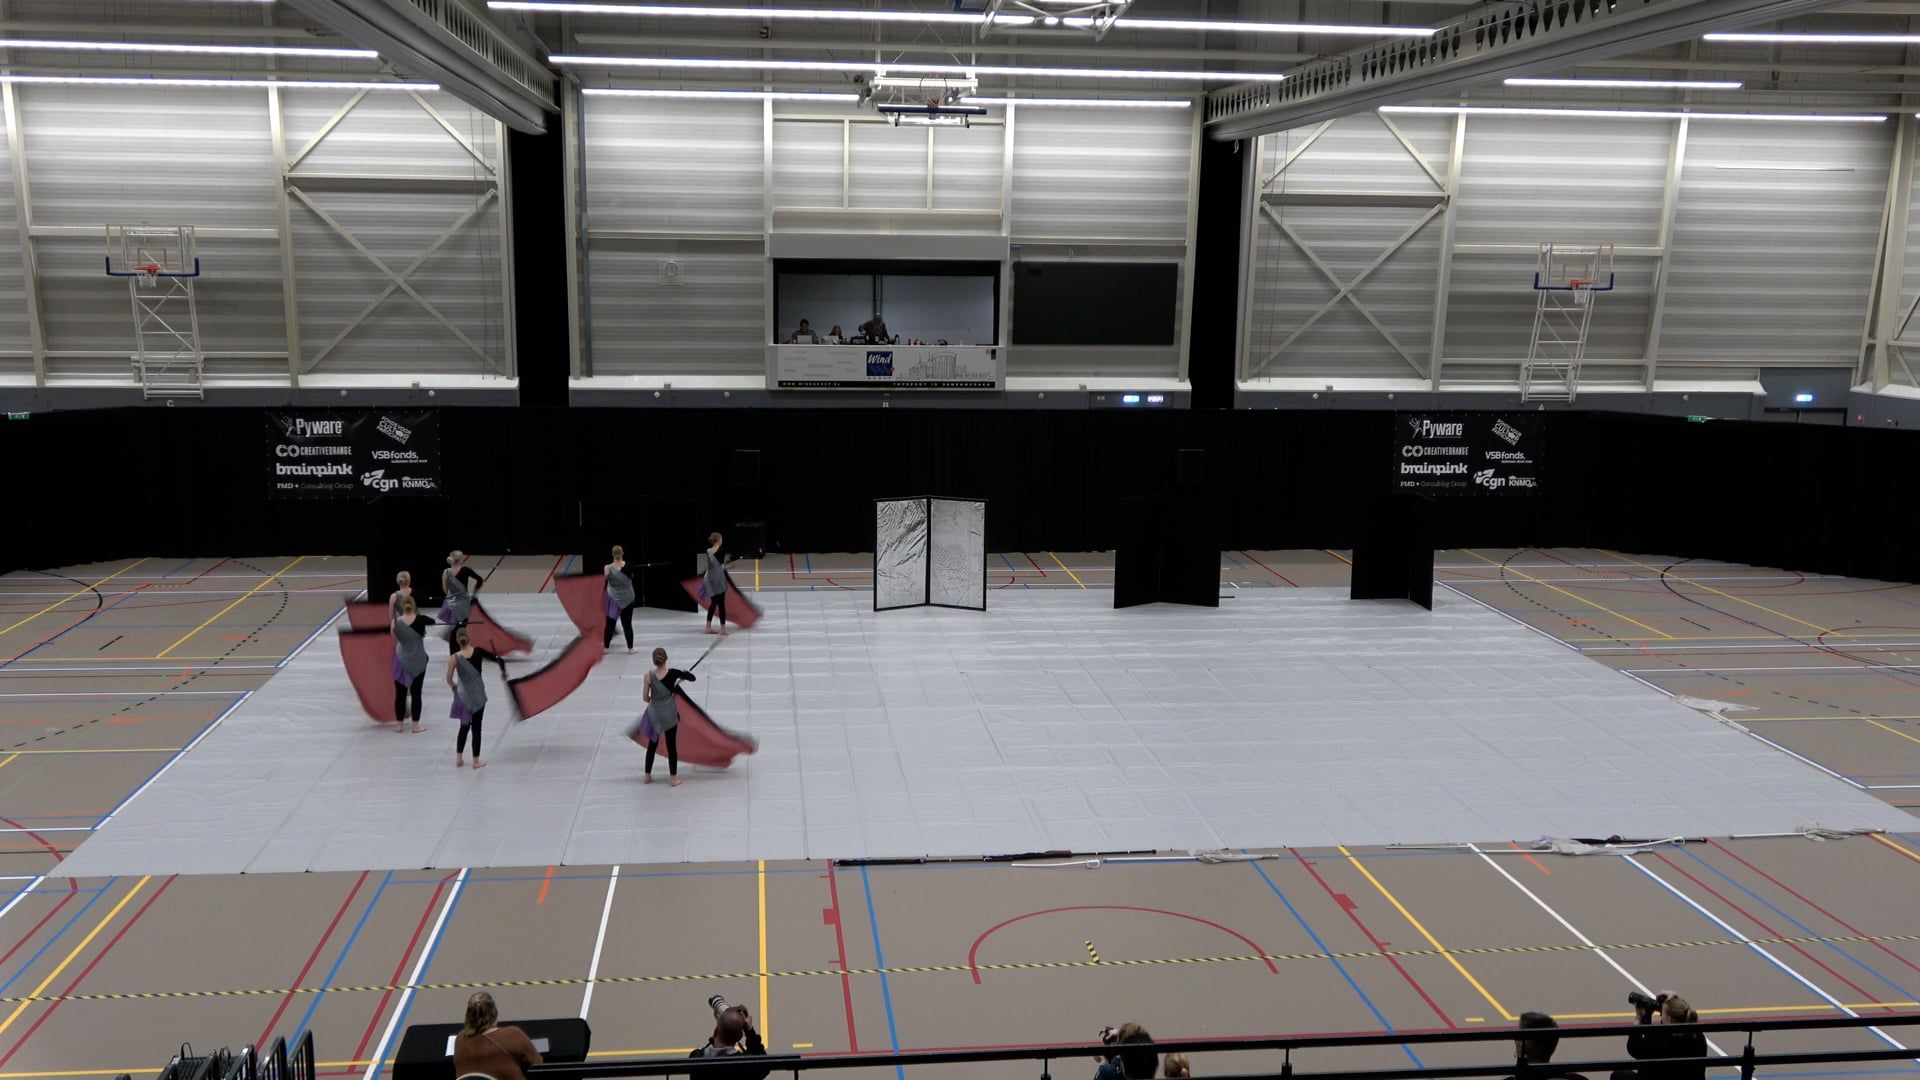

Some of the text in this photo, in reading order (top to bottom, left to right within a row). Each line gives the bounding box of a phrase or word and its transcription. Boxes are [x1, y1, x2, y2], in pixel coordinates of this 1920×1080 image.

[867, 353, 891, 365] Wind
[295, 418, 343, 438] Pyware
[1422, 419, 1463, 439] Pyware
[275, 463, 353, 477] brainpink
[1400, 462, 1468, 476] brainpink
[372, 478, 399, 492] cgn
[1483, 476, 1506, 490] cgn
